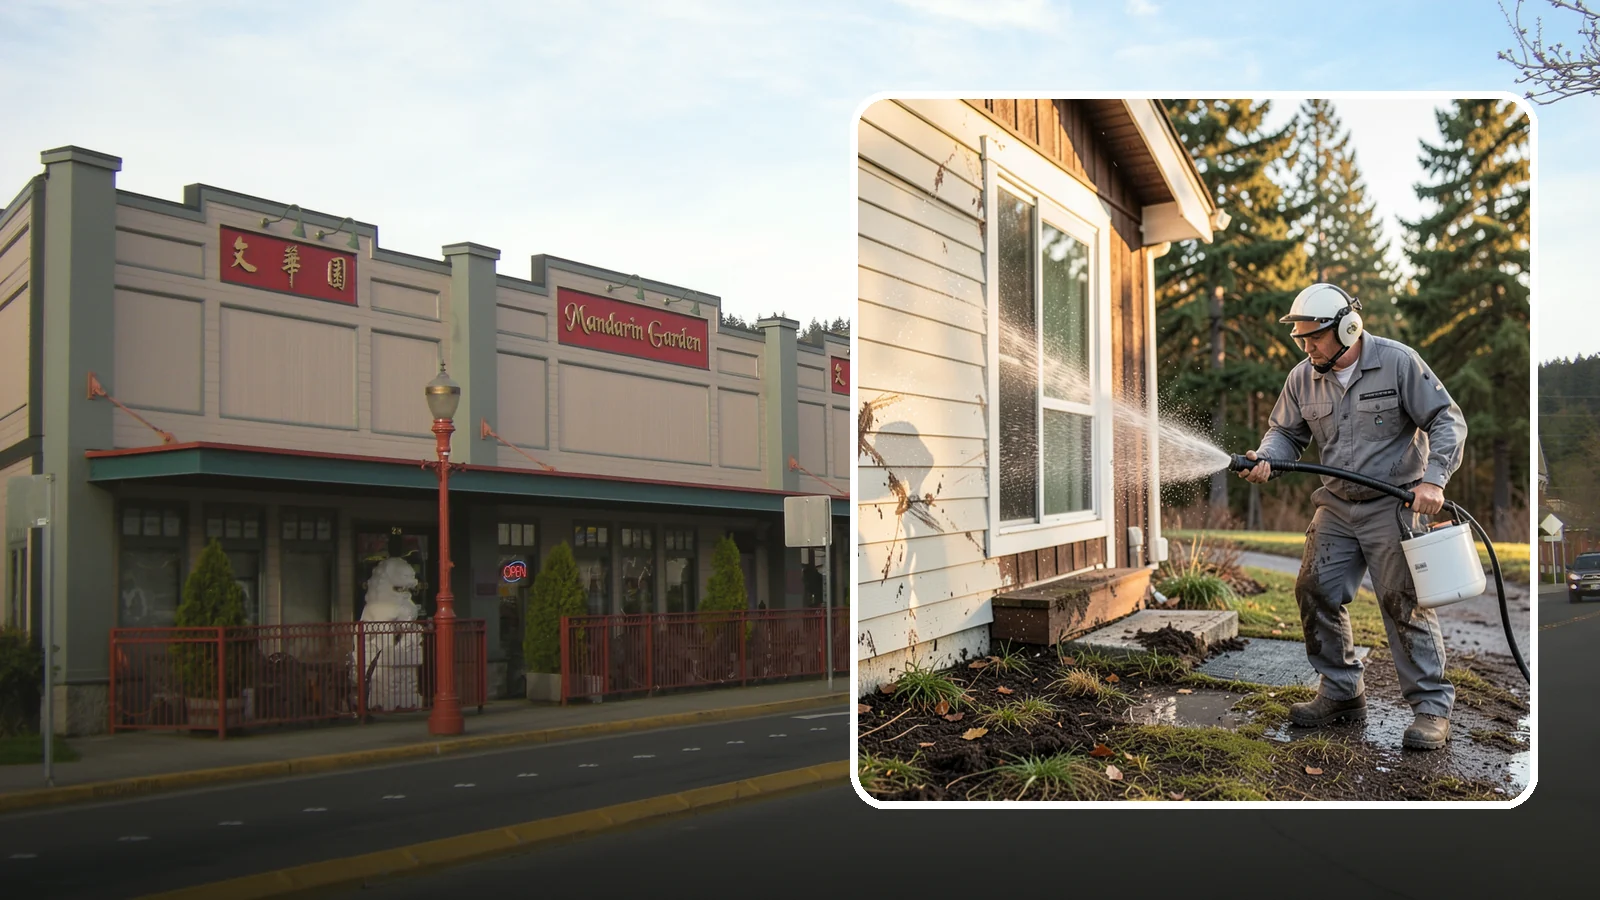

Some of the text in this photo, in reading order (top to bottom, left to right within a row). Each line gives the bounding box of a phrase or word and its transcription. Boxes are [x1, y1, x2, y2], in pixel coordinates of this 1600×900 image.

[231, 236, 346, 291] 文華園
[564, 302, 701, 352] Mandarin Garden
[503, 565, 527, 578] OPEN
